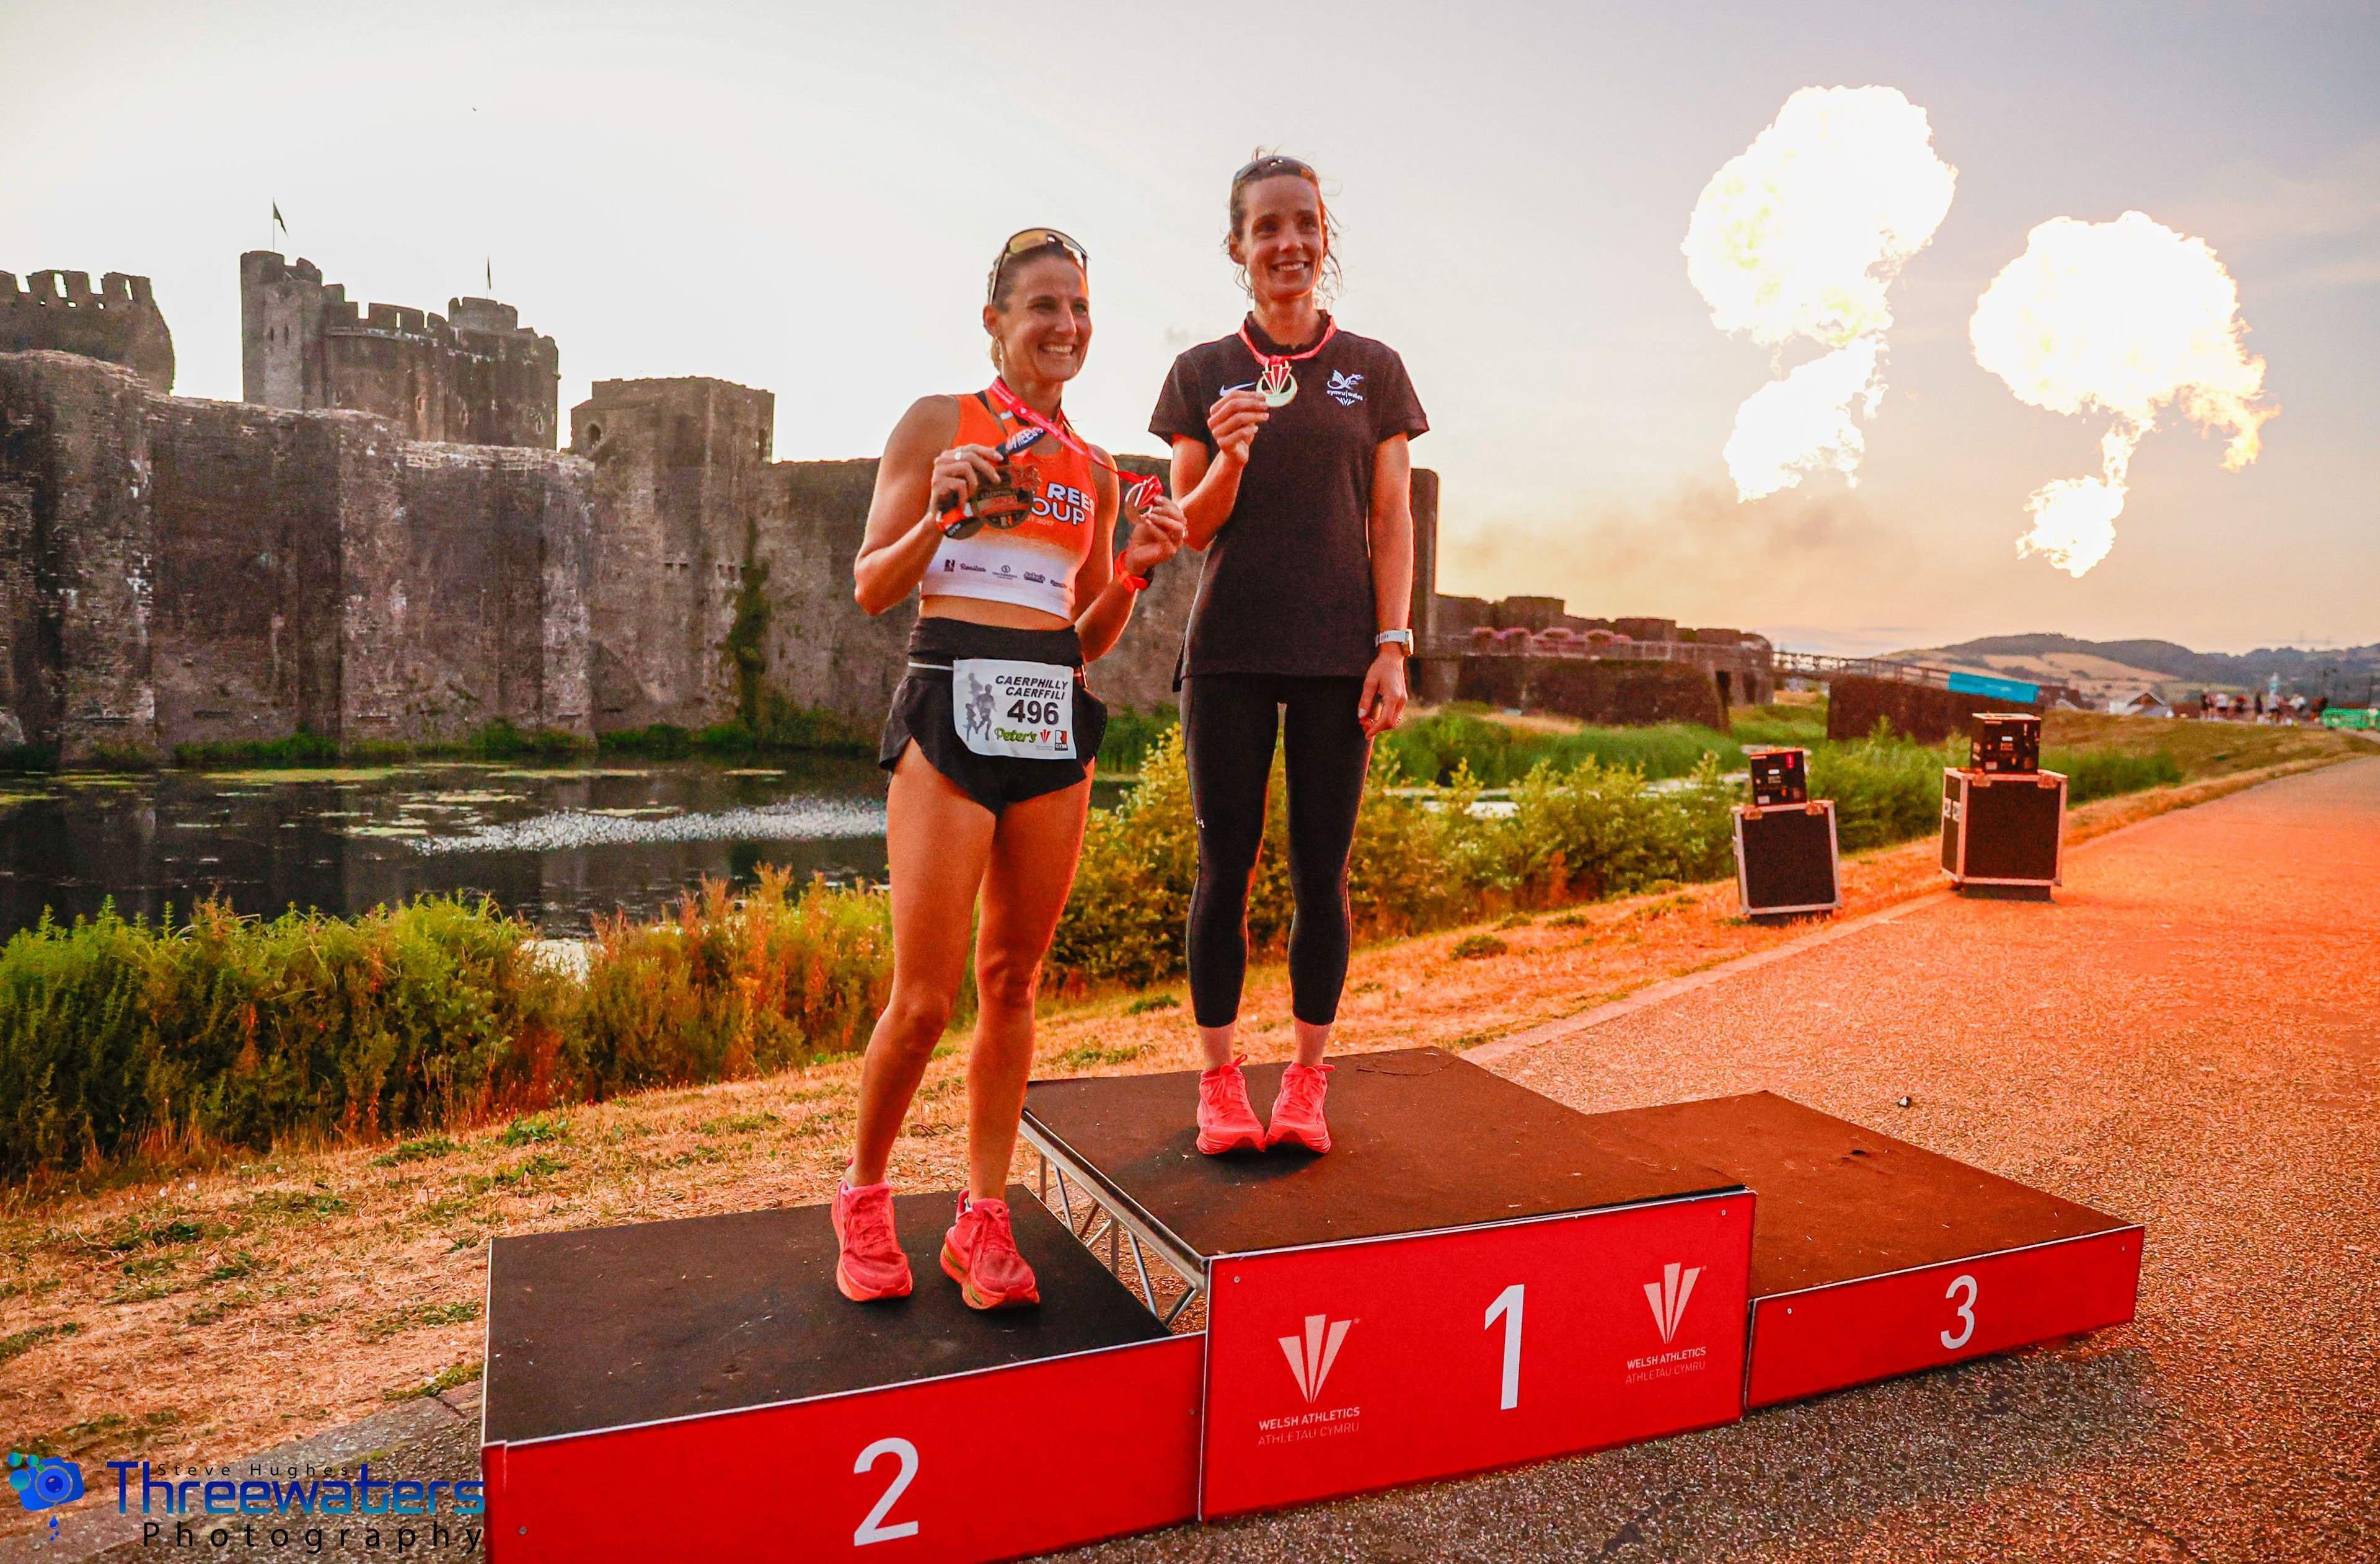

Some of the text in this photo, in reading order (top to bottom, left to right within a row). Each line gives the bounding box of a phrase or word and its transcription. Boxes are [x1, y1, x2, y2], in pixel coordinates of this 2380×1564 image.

[1031, 497, 1085, 526] OUP
[1047, 482, 1095, 517] REES
[995, 675, 1068, 690] CAERPHILLY
[1006, 687, 1065, 700] CAERFFILI
[1007, 699, 1059, 725] 496
[994, 727, 1037, 743] Peter's
[1941, 1275, 1978, 1350] 3
[1484, 1284, 1525, 1410] 1
[1627, 1346, 1706, 1370] WELSH ATHLETICS
[1626, 1360, 1706, 1384] ATHLETAU CYMRU
[1259, 1407, 1360, 1431] WELSH ATHLETICS
[1257, 1421, 1359, 1447] ATHLETAU CYMRU
[854, 1437, 919, 1547] 2
